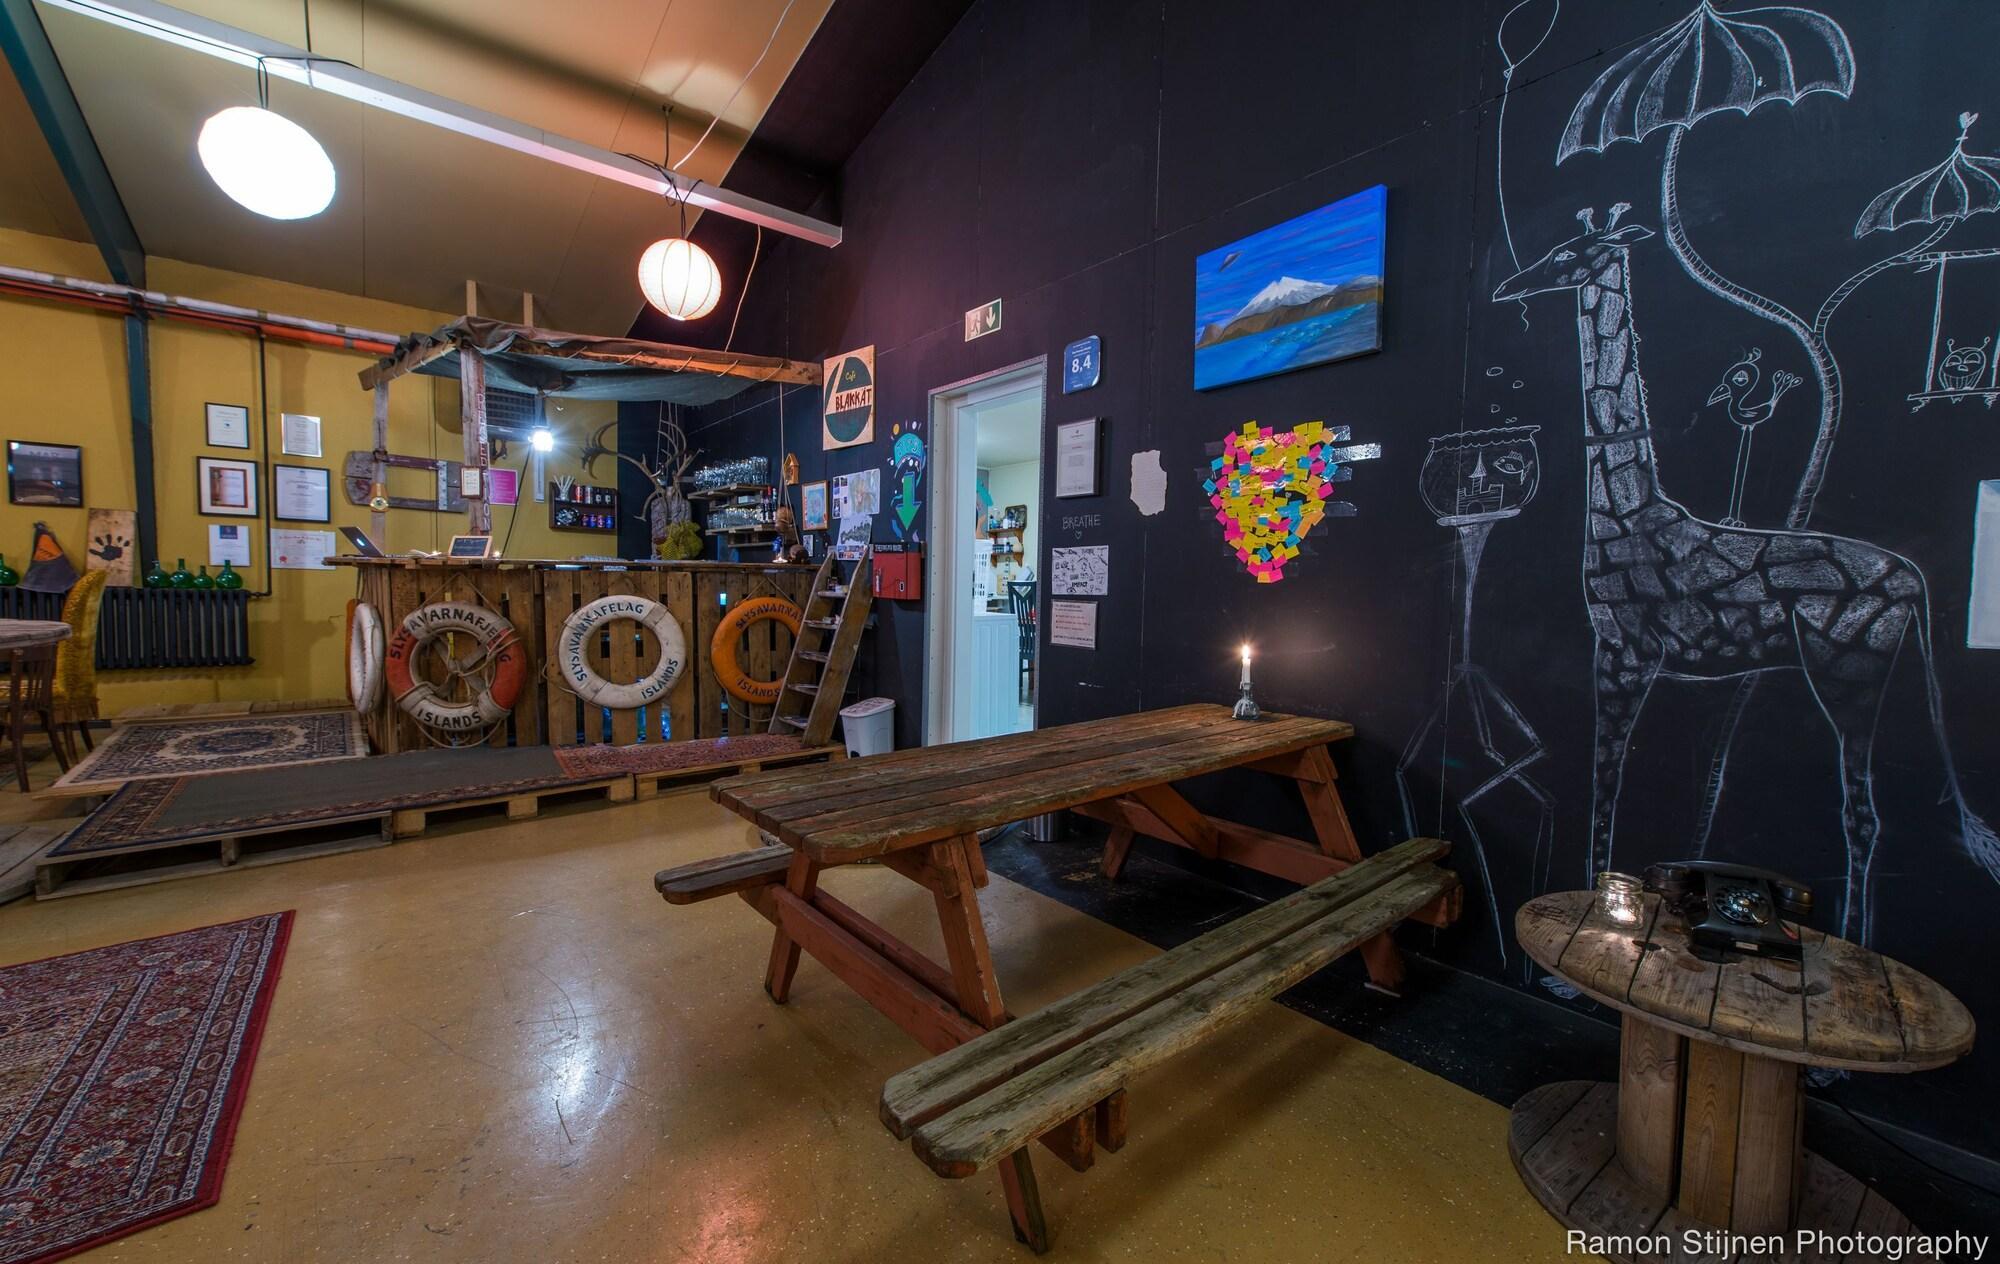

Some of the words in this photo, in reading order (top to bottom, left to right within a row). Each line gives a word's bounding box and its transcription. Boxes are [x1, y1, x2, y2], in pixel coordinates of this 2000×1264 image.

[1072, 354, 1092, 373] 8,4
[1062, 514, 1101, 530] BREATHE
[736, 603, 803, 629] SLYSAVARNA
